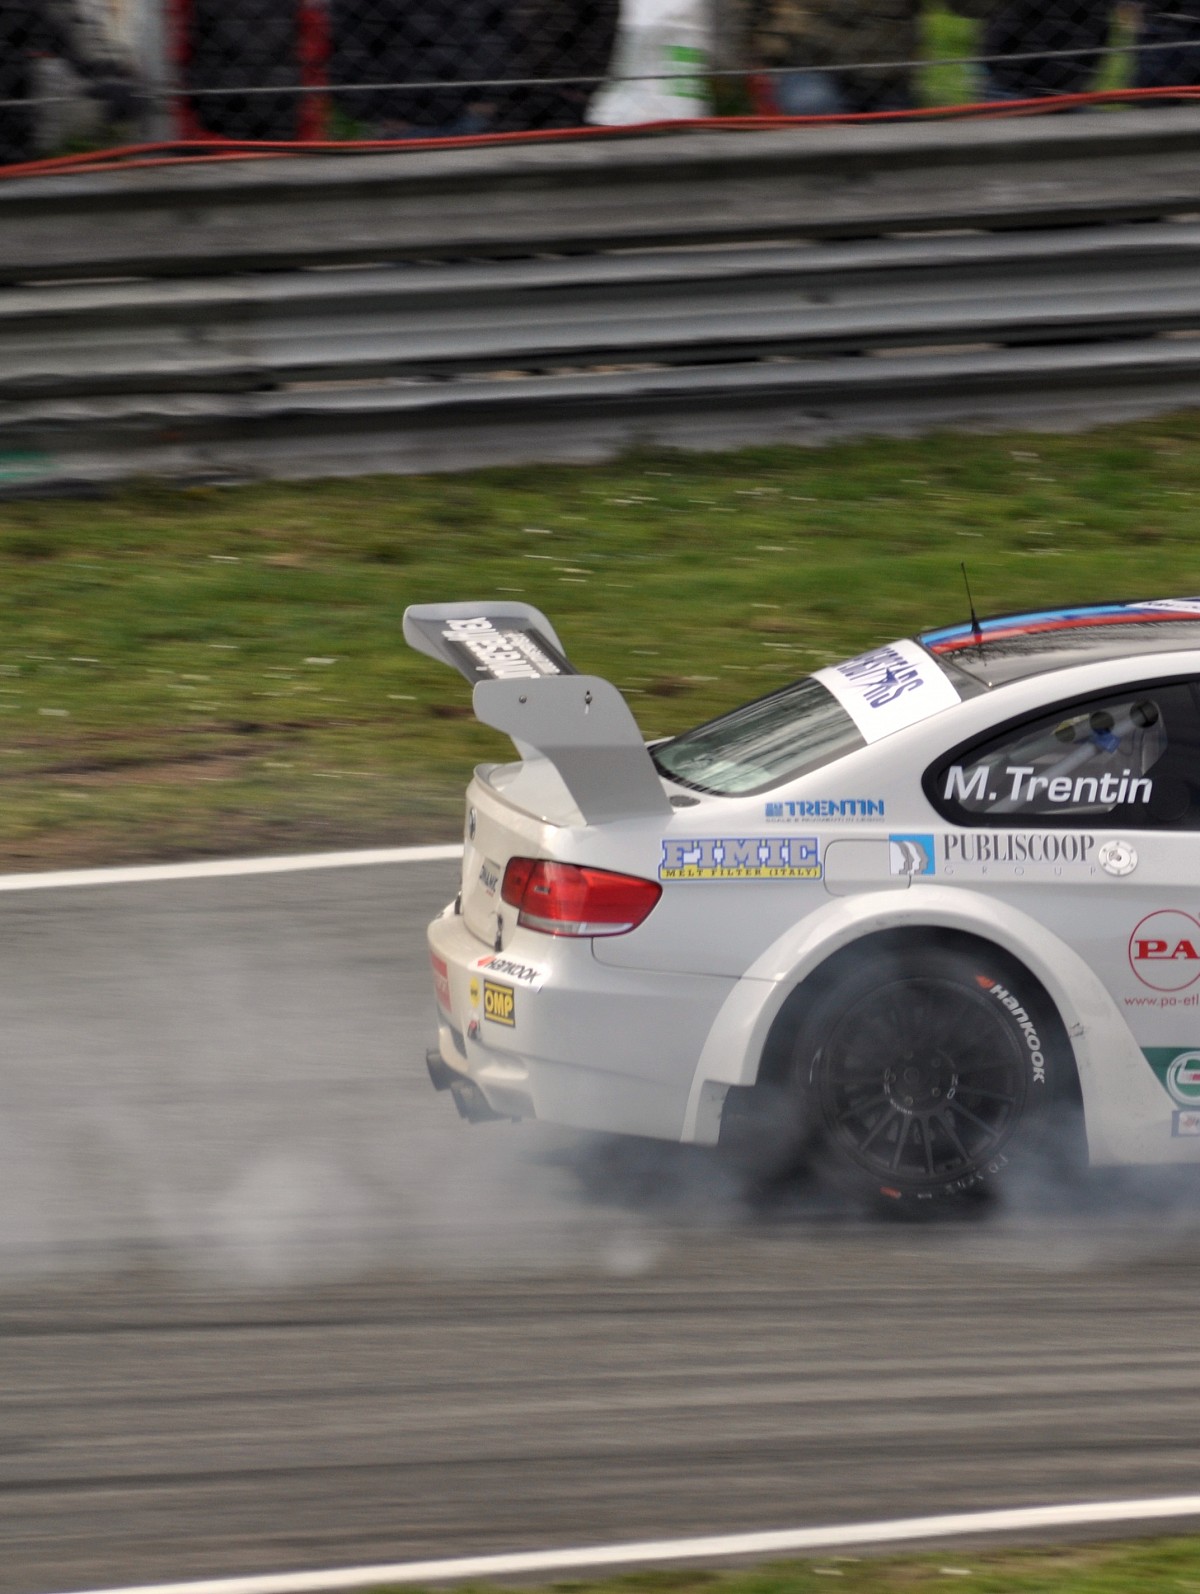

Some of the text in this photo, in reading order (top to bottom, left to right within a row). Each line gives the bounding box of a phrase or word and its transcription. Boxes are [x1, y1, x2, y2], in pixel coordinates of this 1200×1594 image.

[784, 799, 885, 817] TRENTIN
[662, 837, 818, 868] FIMIC
[944, 834, 1095, 863] PUBLISCOOP
[665, 868, 703, 878] MELT
[711, 868, 762, 878] FILTER
[485, 990, 513, 1017] OMP
